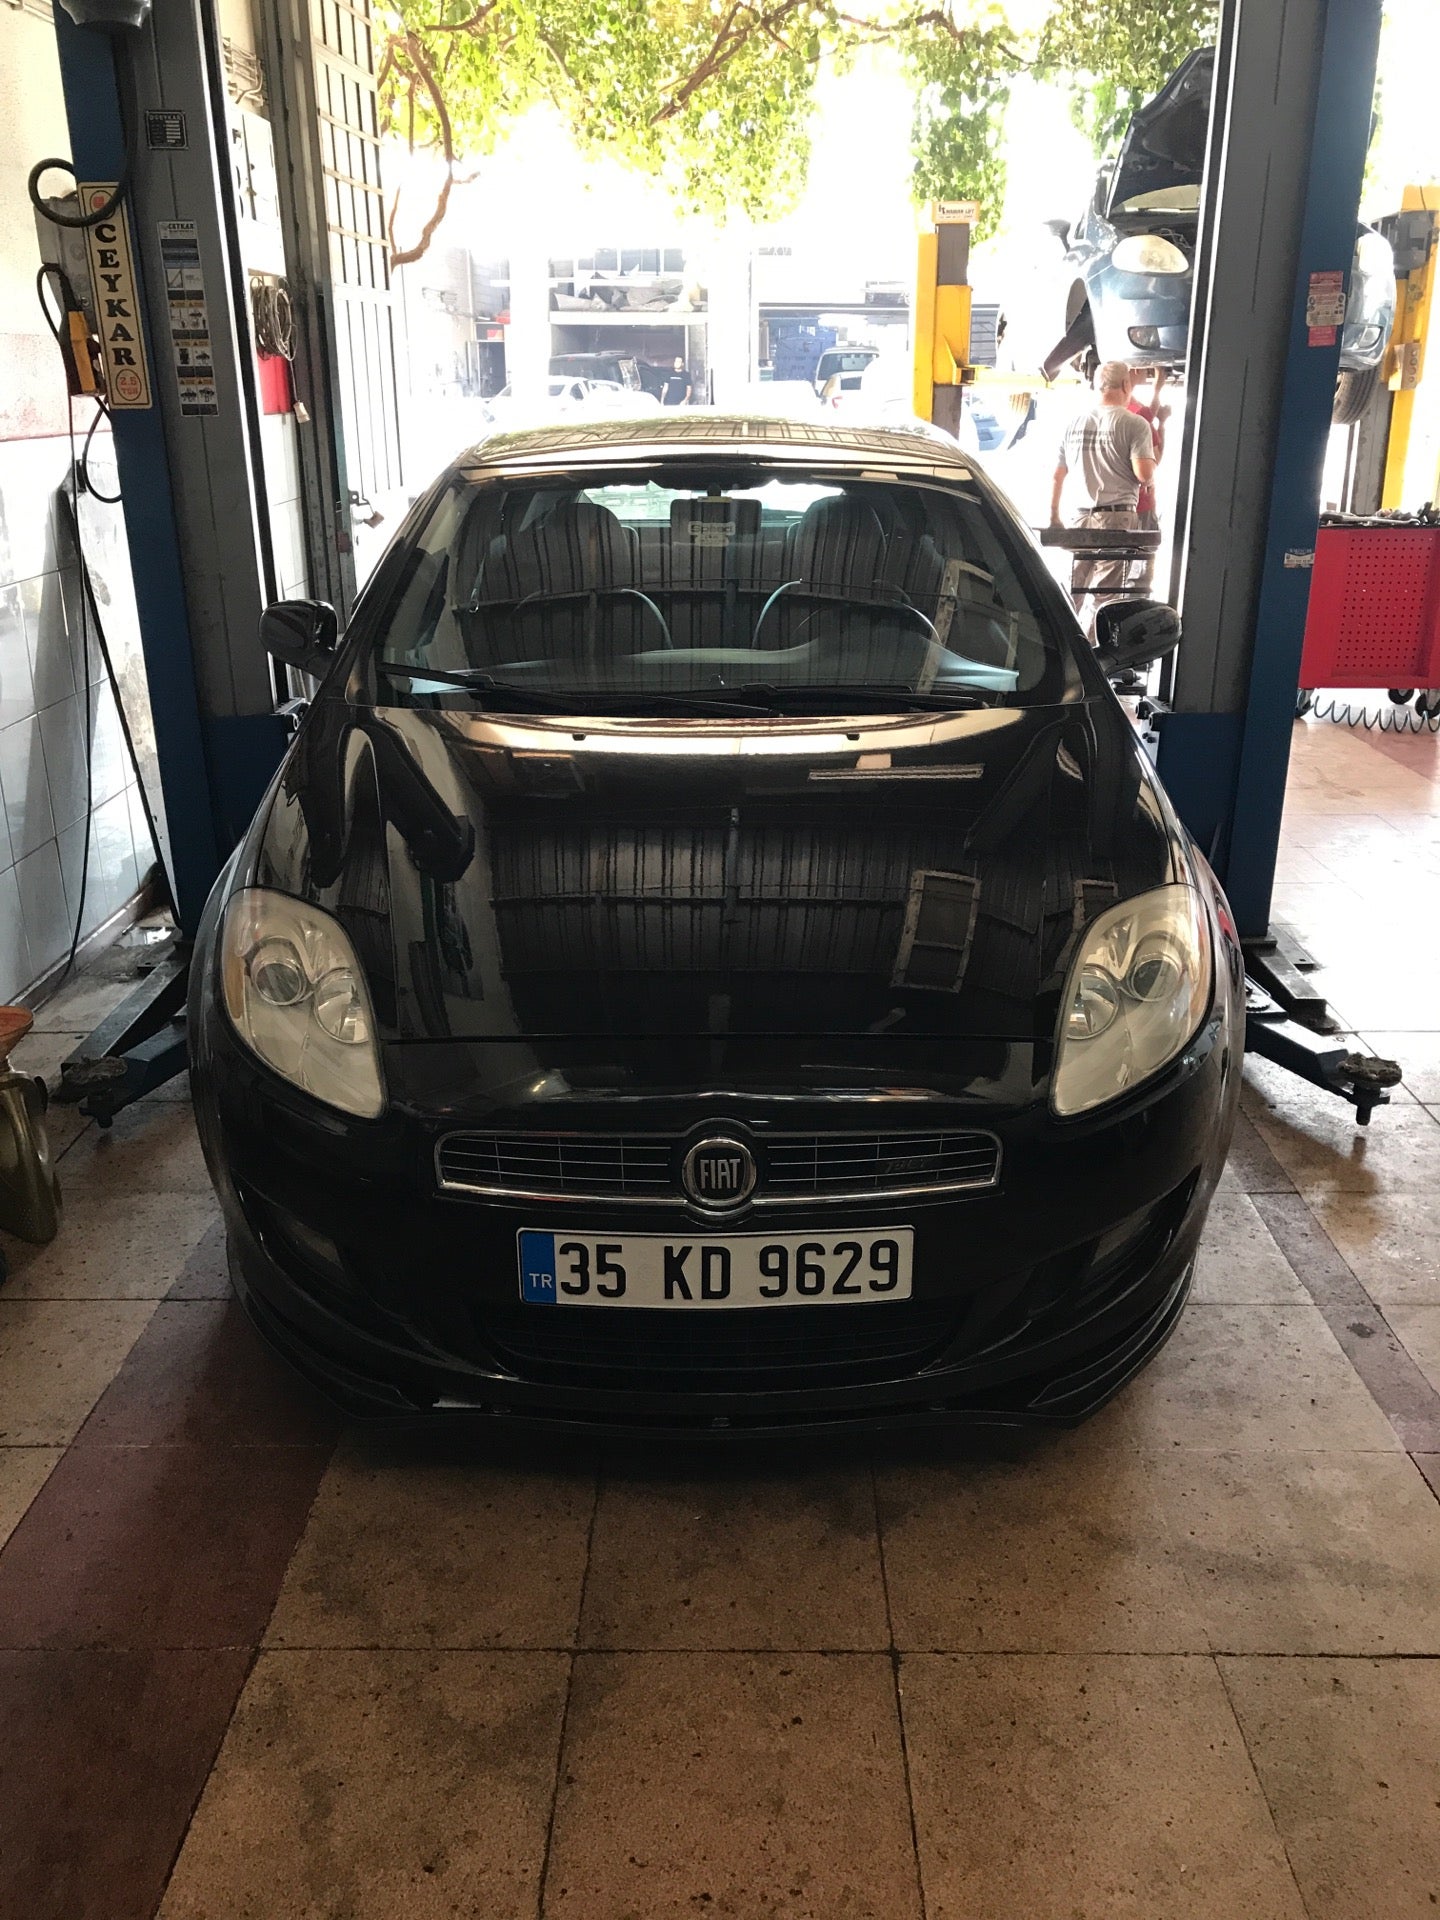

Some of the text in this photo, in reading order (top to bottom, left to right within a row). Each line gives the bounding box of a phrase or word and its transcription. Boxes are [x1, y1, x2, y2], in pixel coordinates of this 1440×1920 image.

[95, 223, 136, 366] CEYKAR
[119, 377, 137, 386] 2.5
[700, 1159, 741, 1189] FIAT
[529, 1272, 553, 1289] TR
[560, 1239, 899, 1300] 35 KD 9629
